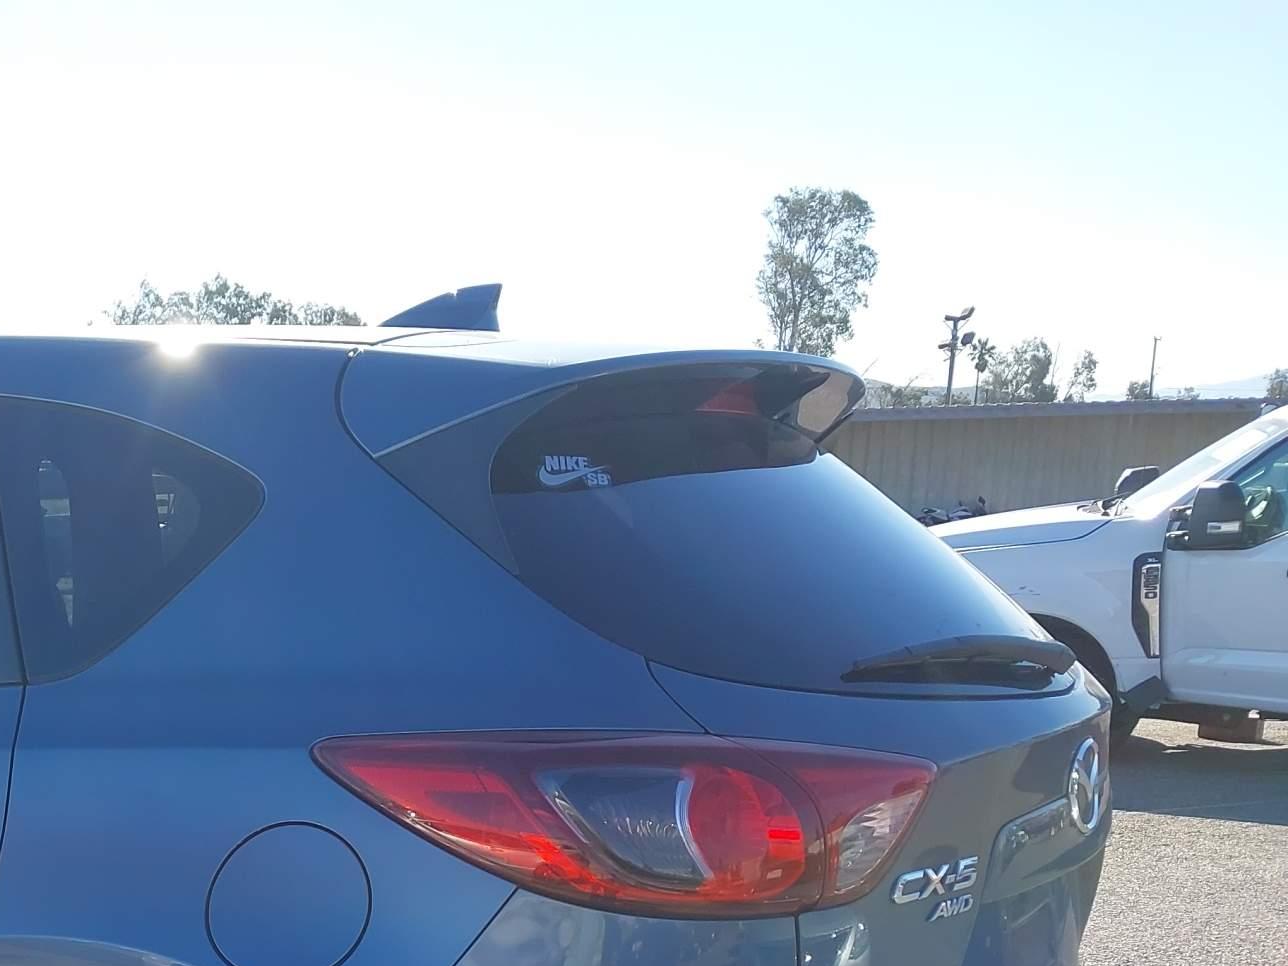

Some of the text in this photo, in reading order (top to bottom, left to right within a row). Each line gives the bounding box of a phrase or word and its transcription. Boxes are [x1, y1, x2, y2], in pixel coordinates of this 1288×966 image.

[545, 455, 588, 471] NIKE
[585, 472, 609, 485] SB
[893, 856, 978, 904] CX-5
[928, 894, 973, 921] AWD
